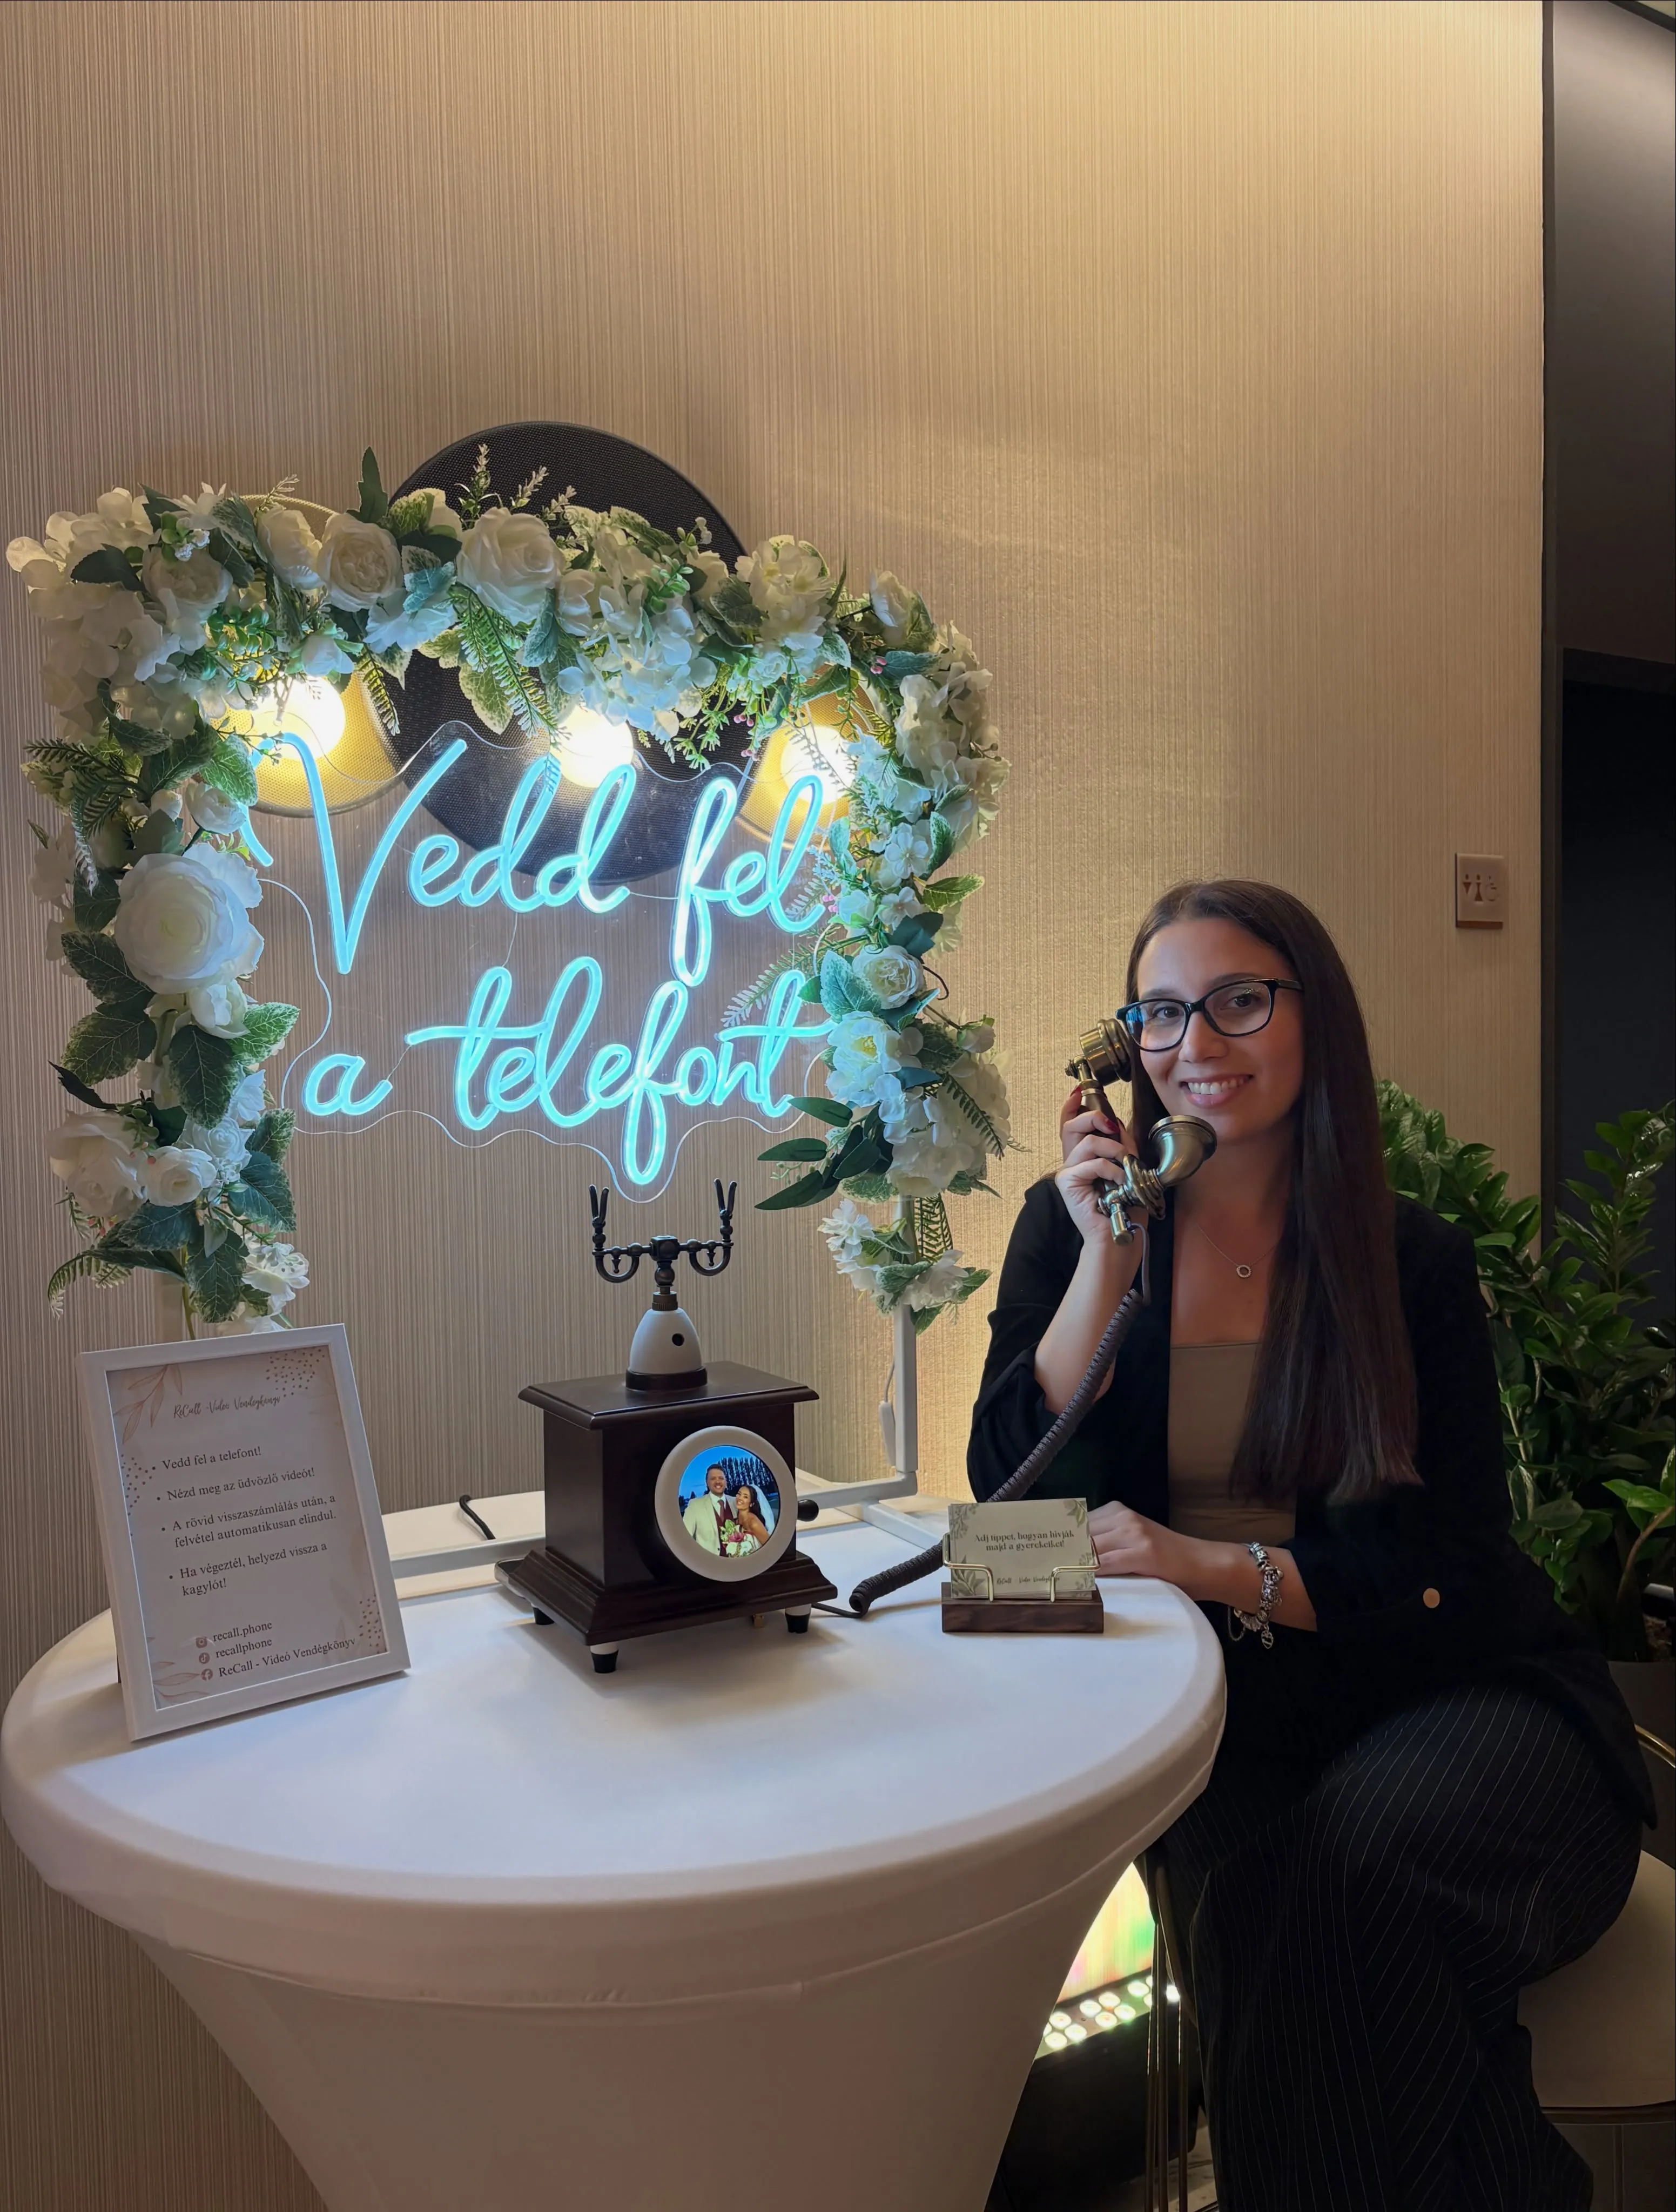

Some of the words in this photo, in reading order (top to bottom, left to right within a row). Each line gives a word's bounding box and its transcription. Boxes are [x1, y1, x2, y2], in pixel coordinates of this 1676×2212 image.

[238, 732, 630, 974] Vedd
[671, 777, 825, 986] fel
[302, 1053, 393, 1115] a
[405, 956, 836, 1185] telefont
[163, 1456, 191, 1469] Vedd
[194, 1454, 207, 1465] fel
[219, 1446, 261, 1461] telefont!
[167, 1487, 196, 1500] Nézd
[199, 1486, 221, 1495] meg
[224, 1483, 235, 1491] az
[238, 1473, 278, 1489] üdvözlő
[281, 1467, 315, 1482] videót!
[173, 1520, 181, 1531] A
[186, 1514, 214, 1528] rövid
[217, 1501, 298, 1522] visszaszámlálás
[301, 1496, 327, 1508] után,
[175, 1531, 214, 1548] felvétel
[217, 1519, 297, 1540] automatikusan
[299, 1510, 336, 1525] elindul.
[974, 1534, 989, 1543] Adj
[1018, 1532, 1048, 1541] hogyan
[986, 1542, 1006, 1552] majd
[1016, 1540, 1065, 1551] gyerekeiket!
[180, 1568, 197, 1579] Ha
[200, 1557, 246, 1575] végeztél,
[247, 1549, 287, 1566] helyezd
[289, 1544, 319, 1557] vissza
[182, 1577, 227, 1596] kagylót!
[212, 1622, 273, 1642] recall.phone
[216, 1638, 272, 1658] recallphone
[219, 1661, 253, 1677] ReCall
[262, 1652, 291, 1667] Videó
[293, 1637, 356, 1659] Vendégkönyv
